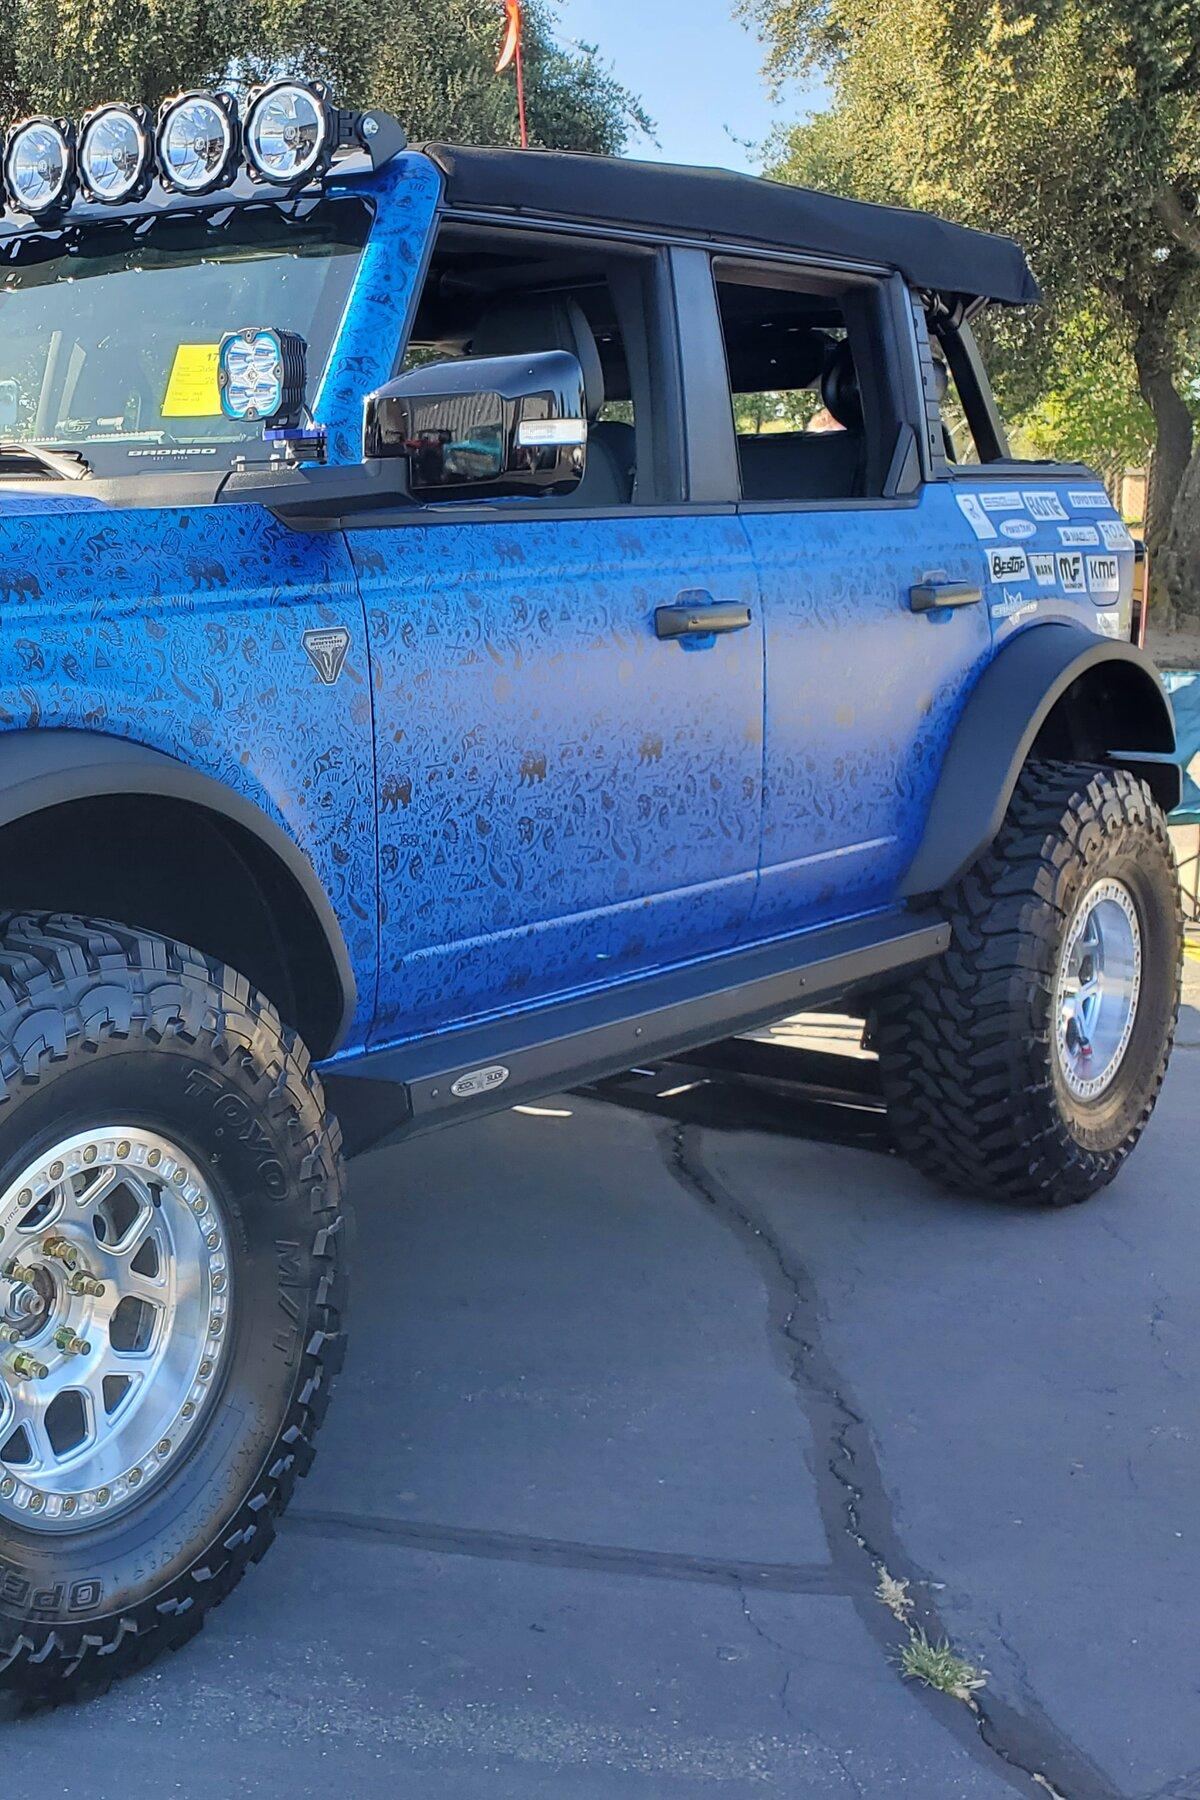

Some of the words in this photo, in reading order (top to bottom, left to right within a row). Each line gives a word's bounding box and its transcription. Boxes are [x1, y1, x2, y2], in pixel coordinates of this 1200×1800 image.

[127, 448, 217, 457] BRONCO
[1035, 563, 1053, 577] WARN
[184, 1068, 290, 1201] TOYO
